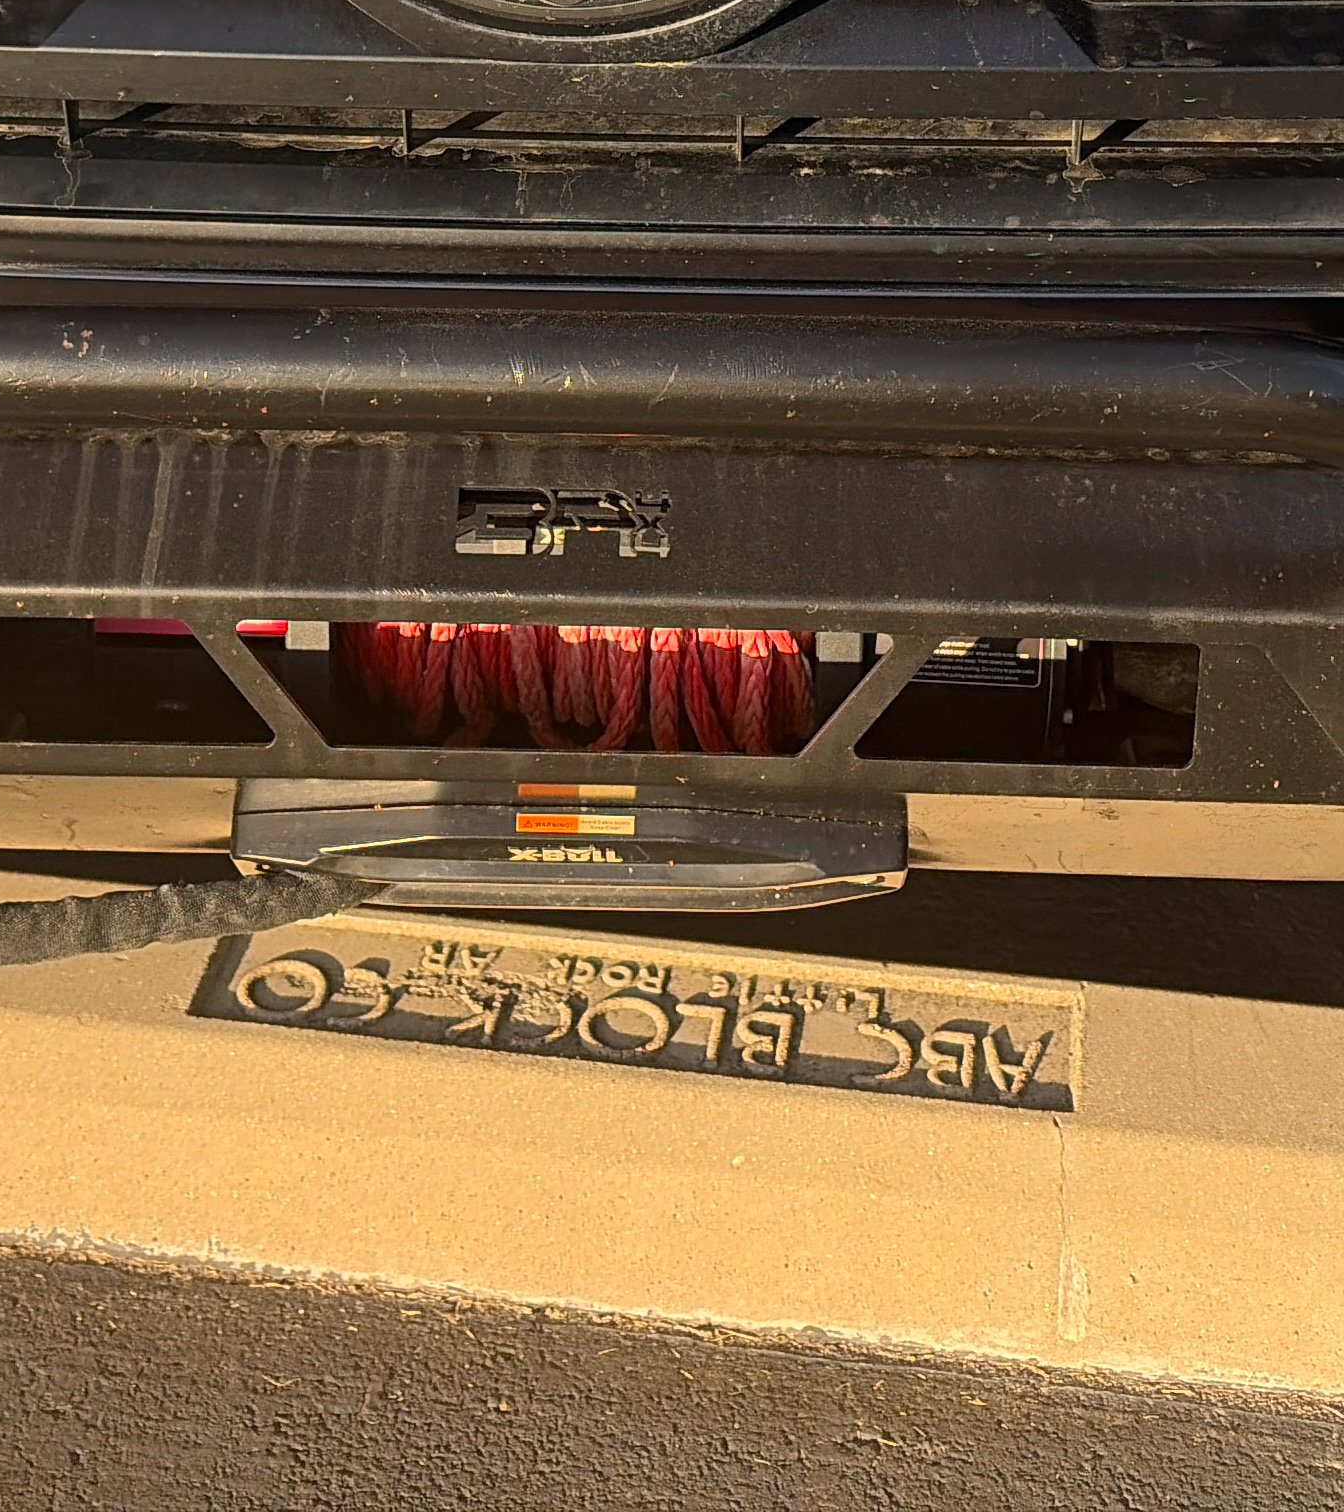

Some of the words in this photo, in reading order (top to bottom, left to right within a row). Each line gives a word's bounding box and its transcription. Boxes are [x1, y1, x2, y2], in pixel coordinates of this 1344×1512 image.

[507, 843, 624, 863] X-BULL
[420, 940, 500, 977] AR
[546, 953, 671, 996] ROCK
[234, 957, 394, 1027] CO
[444, 983, 801, 1070] BLOCK
[854, 1020, 1056, 1095] ABC
